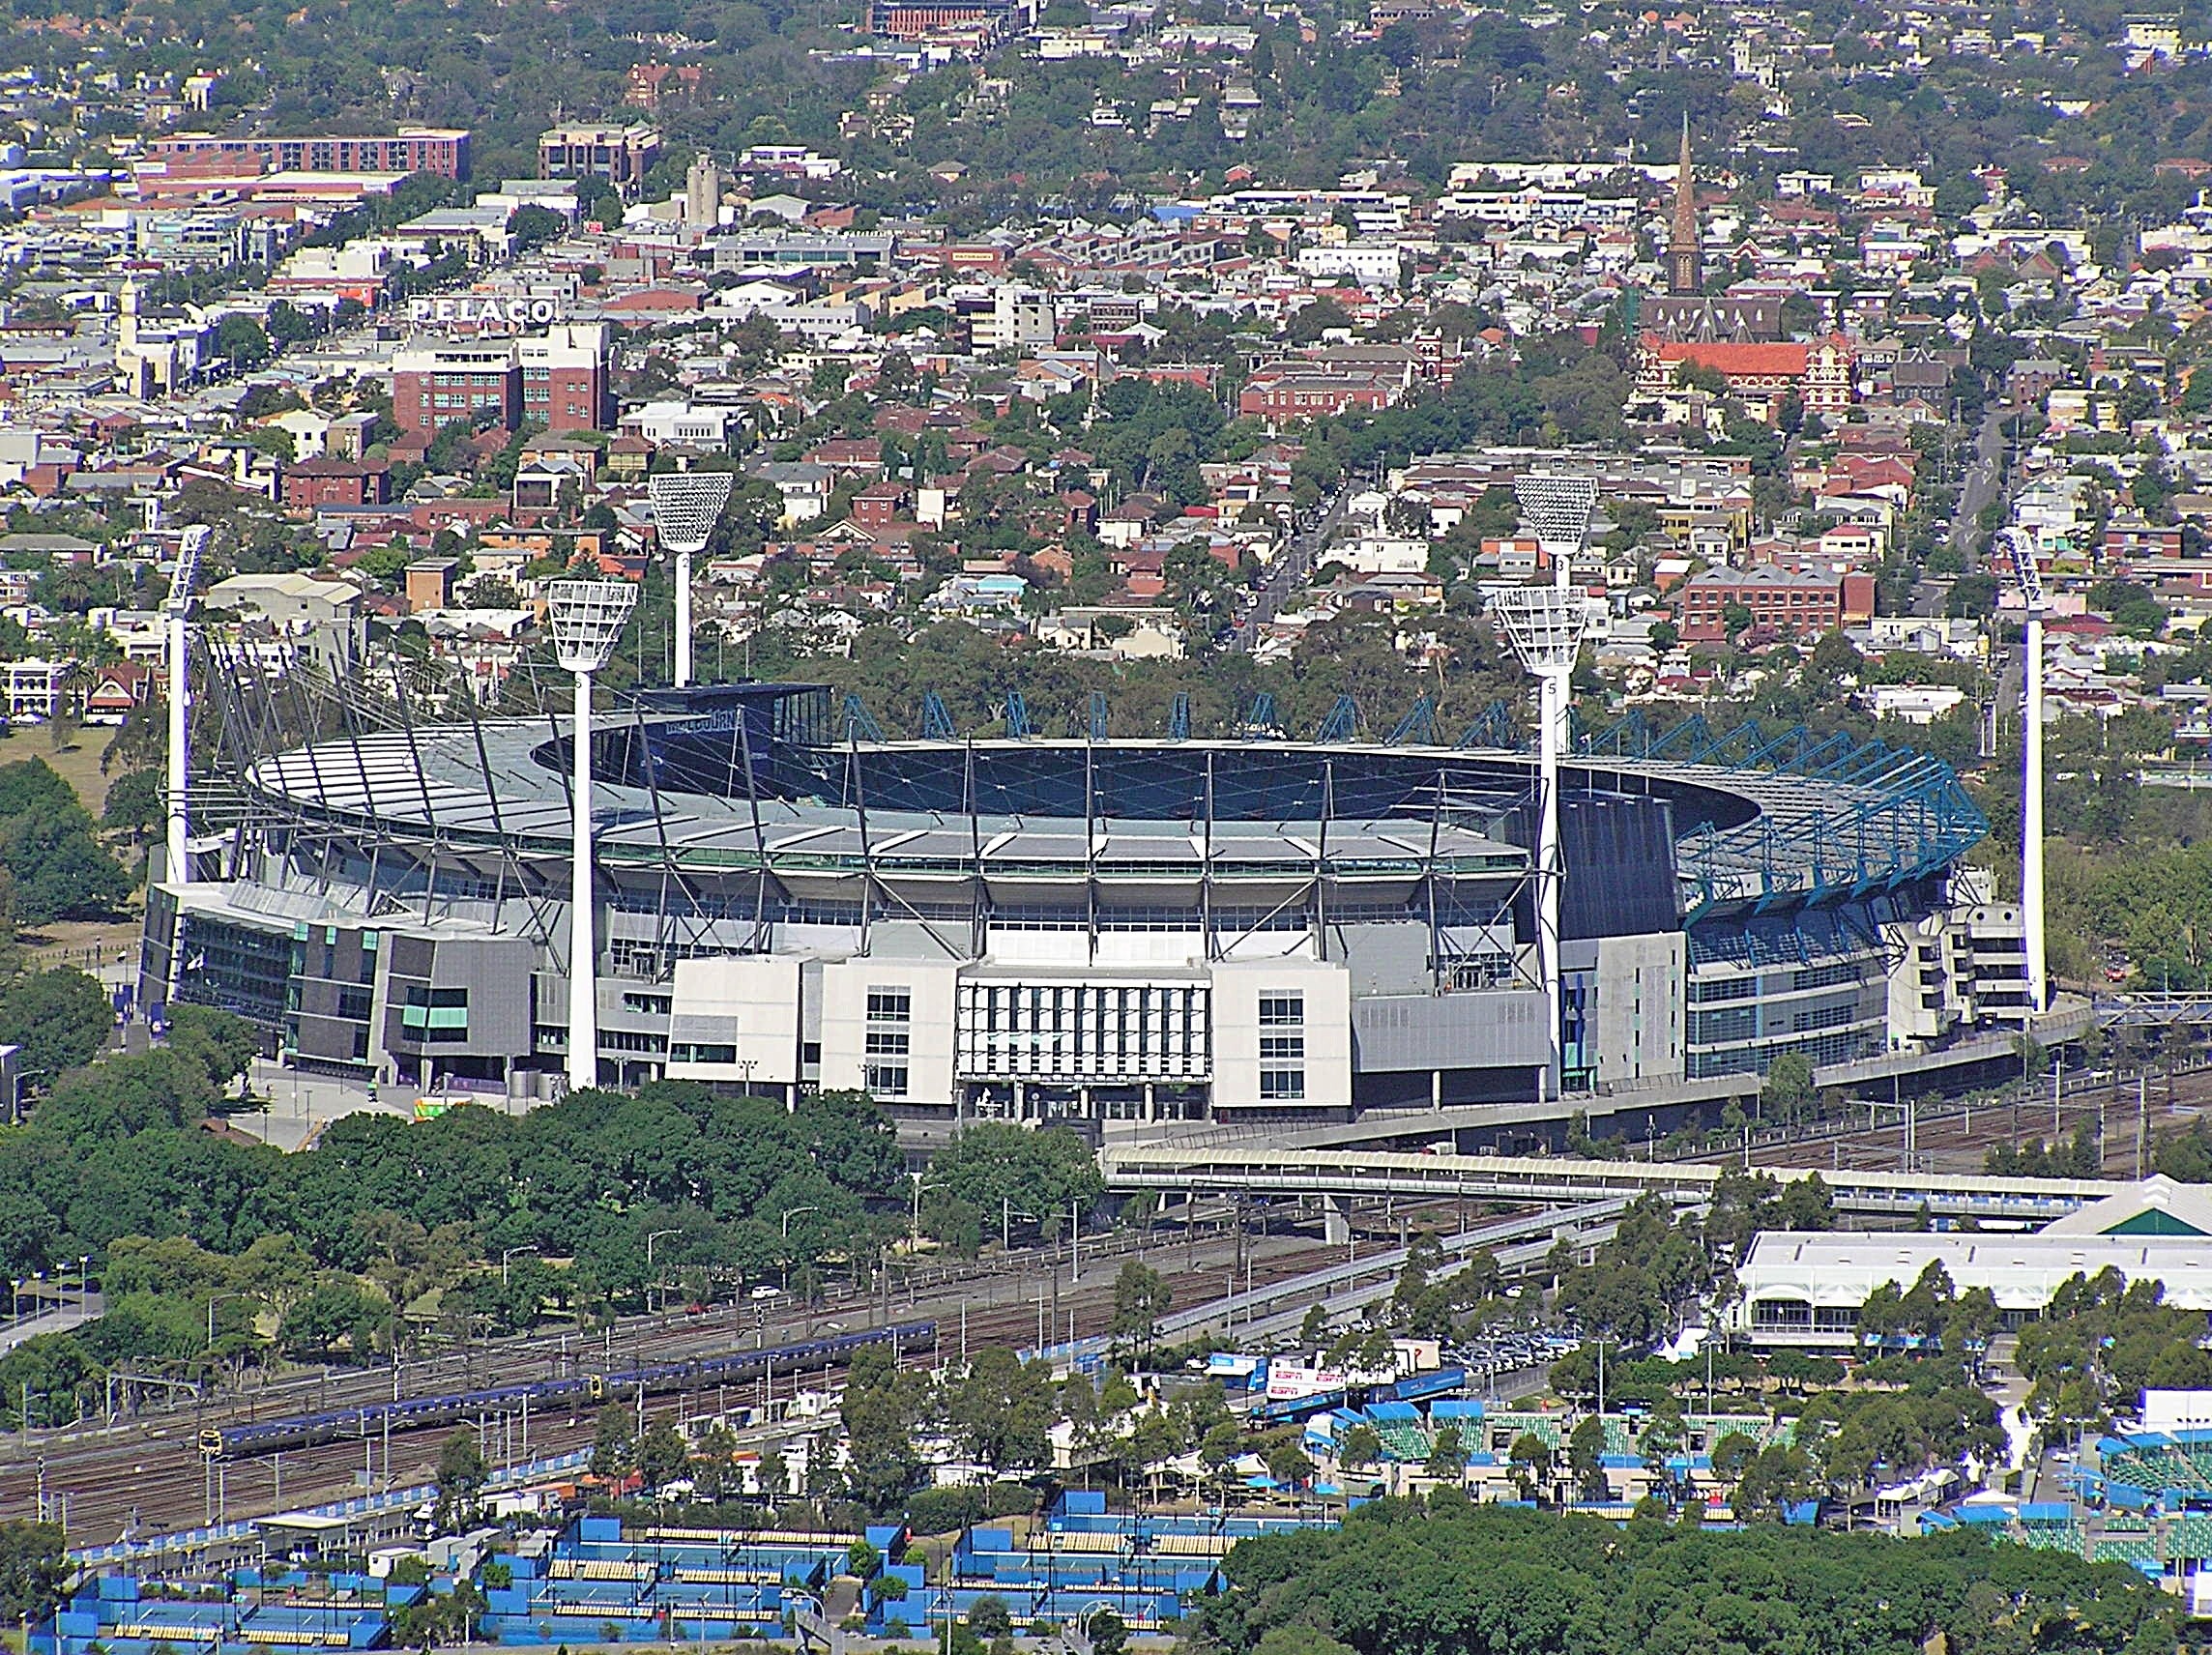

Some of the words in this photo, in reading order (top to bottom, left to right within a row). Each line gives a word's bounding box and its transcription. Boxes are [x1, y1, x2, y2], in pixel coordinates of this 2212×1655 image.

[411, 299, 554, 323] PELACO
[682, 557, 689, 567] 2
[1557, 560, 1563, 571] 3
[575, 678, 582, 688] 6
[1548, 682, 1557, 694] 5
